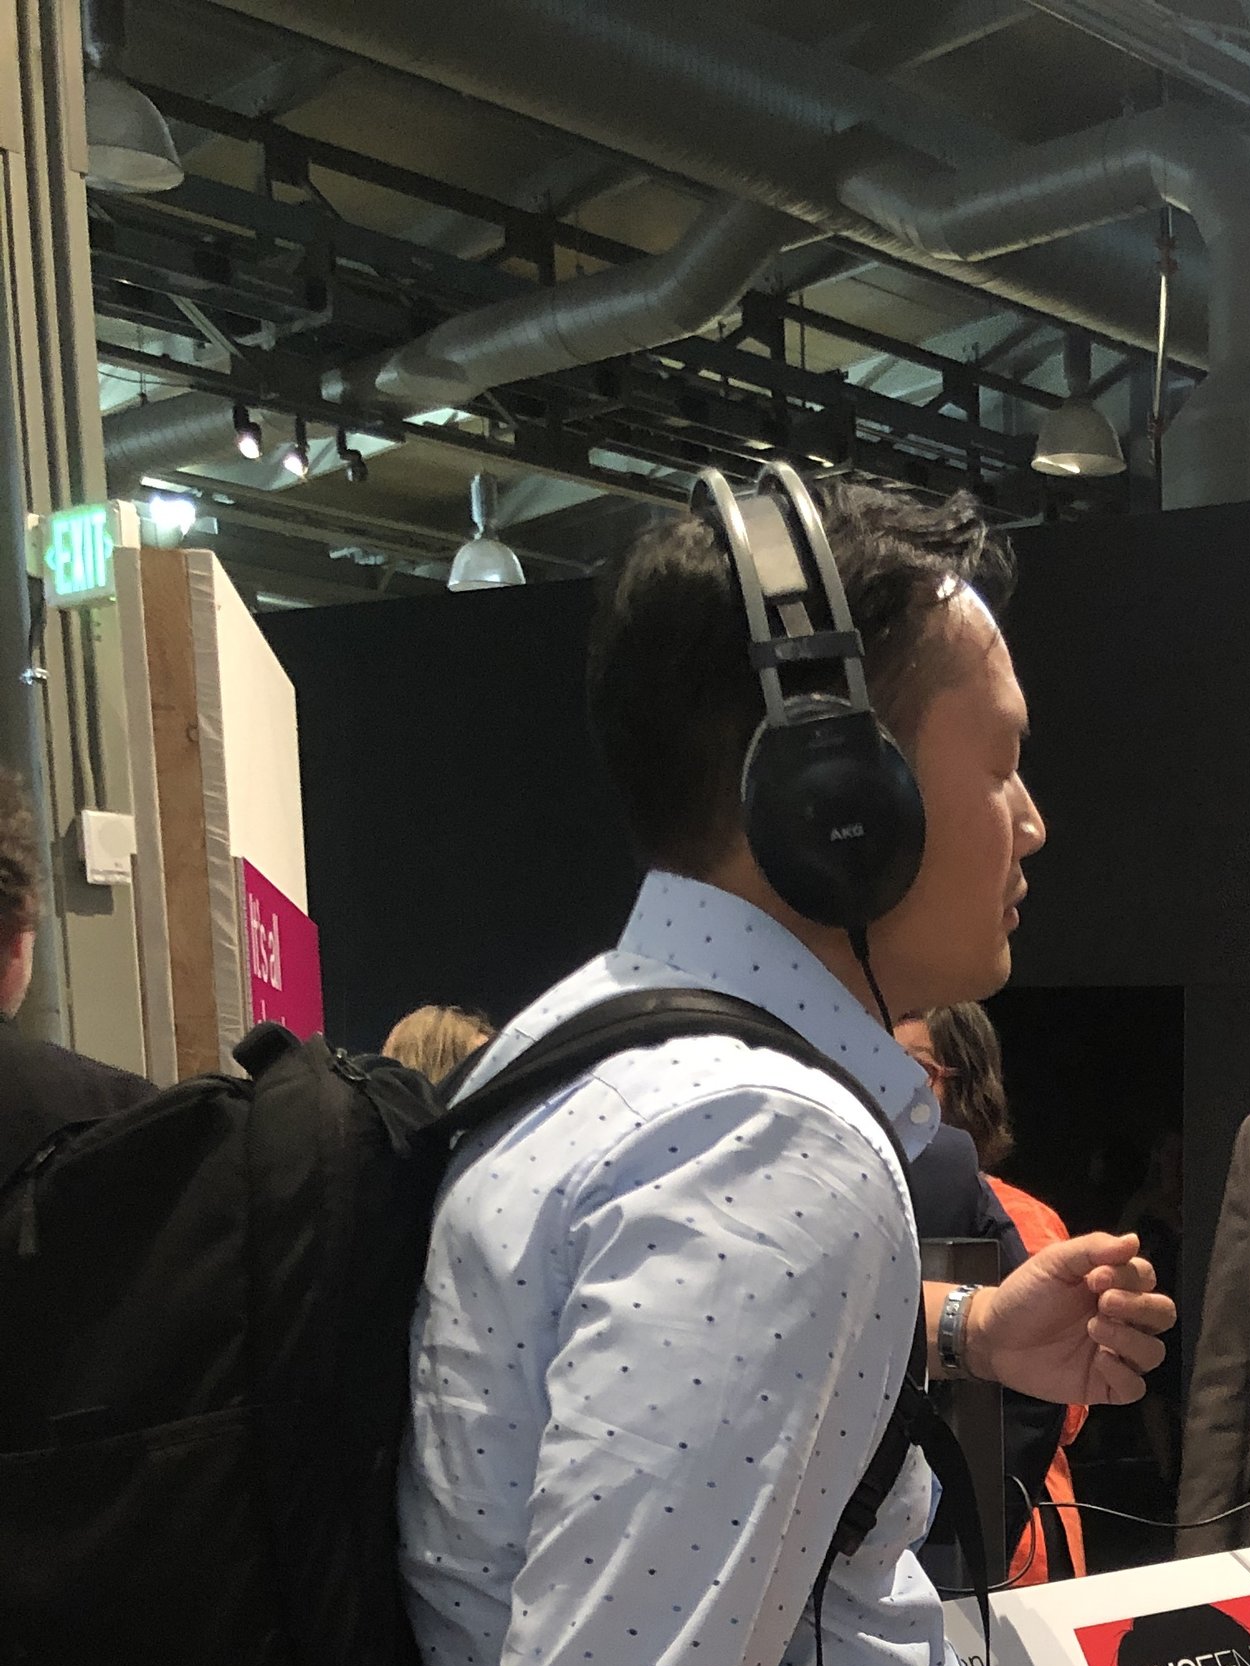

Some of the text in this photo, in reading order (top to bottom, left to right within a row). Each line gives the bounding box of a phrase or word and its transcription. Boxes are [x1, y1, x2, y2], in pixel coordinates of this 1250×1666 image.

[53, 512, 106, 595] EXIT
[829, 823, 865, 841] AKG
[268, 913, 283, 991] all
